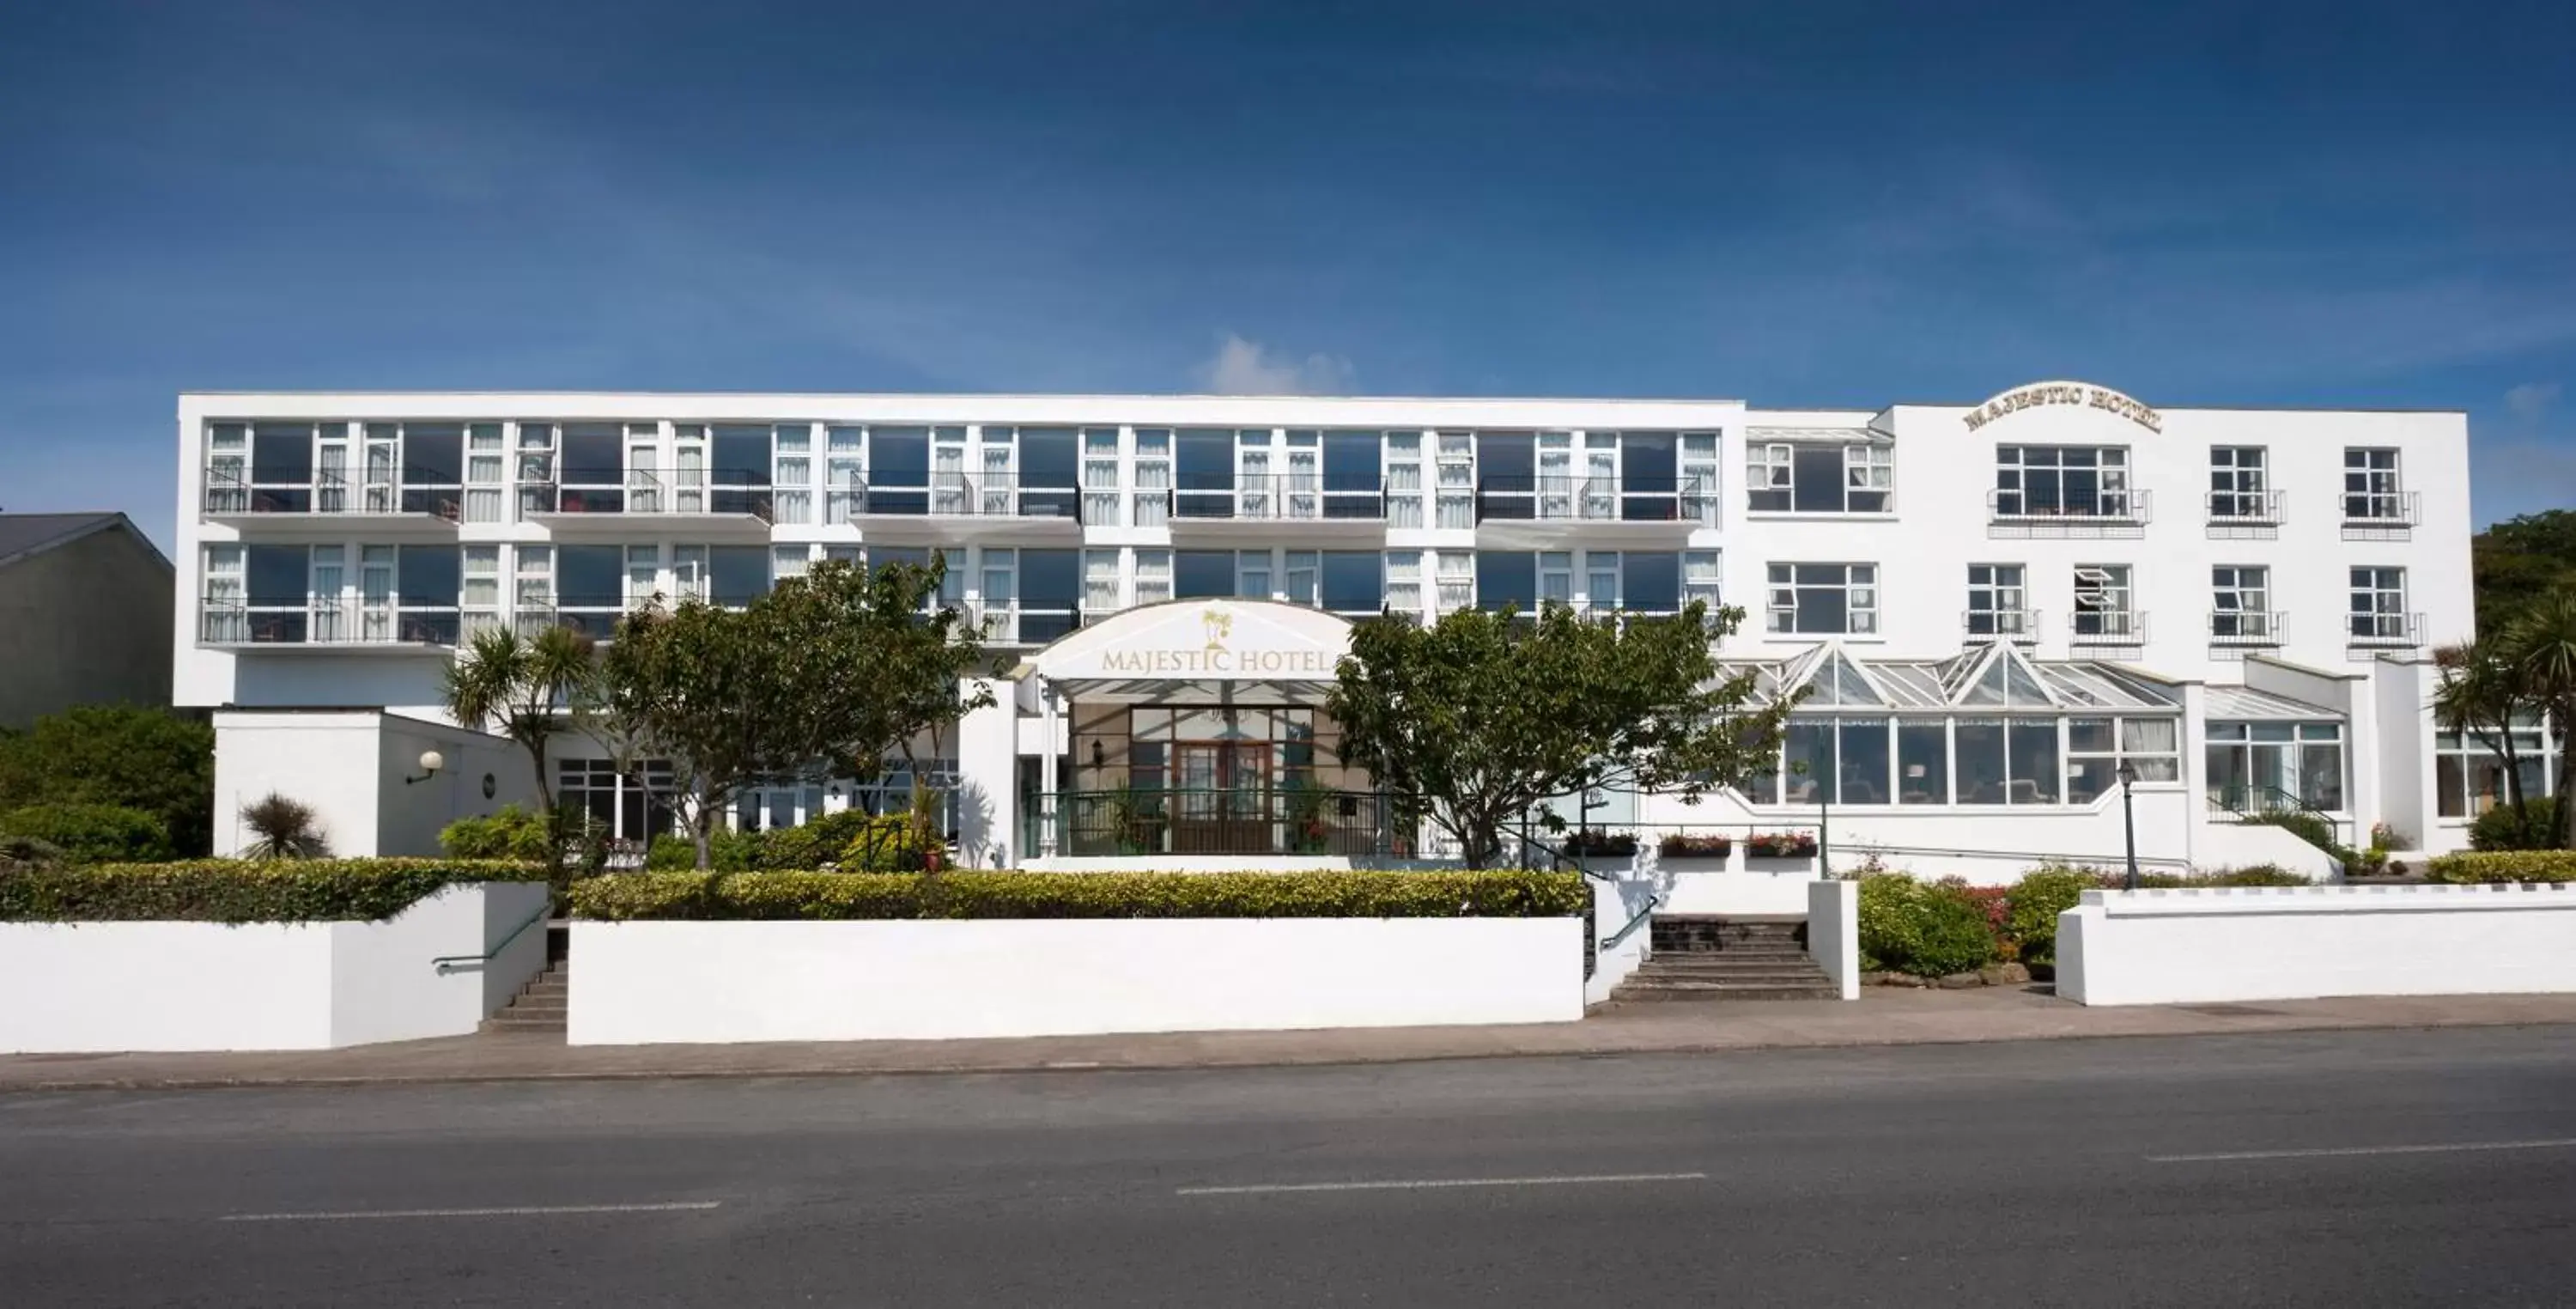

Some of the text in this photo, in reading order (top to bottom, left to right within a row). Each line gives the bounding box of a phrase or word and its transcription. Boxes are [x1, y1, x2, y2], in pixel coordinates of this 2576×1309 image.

[1963, 387, 2162, 435] MAJESTIC HOTEL
[1102, 649, 1331, 674] MAJESTIC HOTEL
